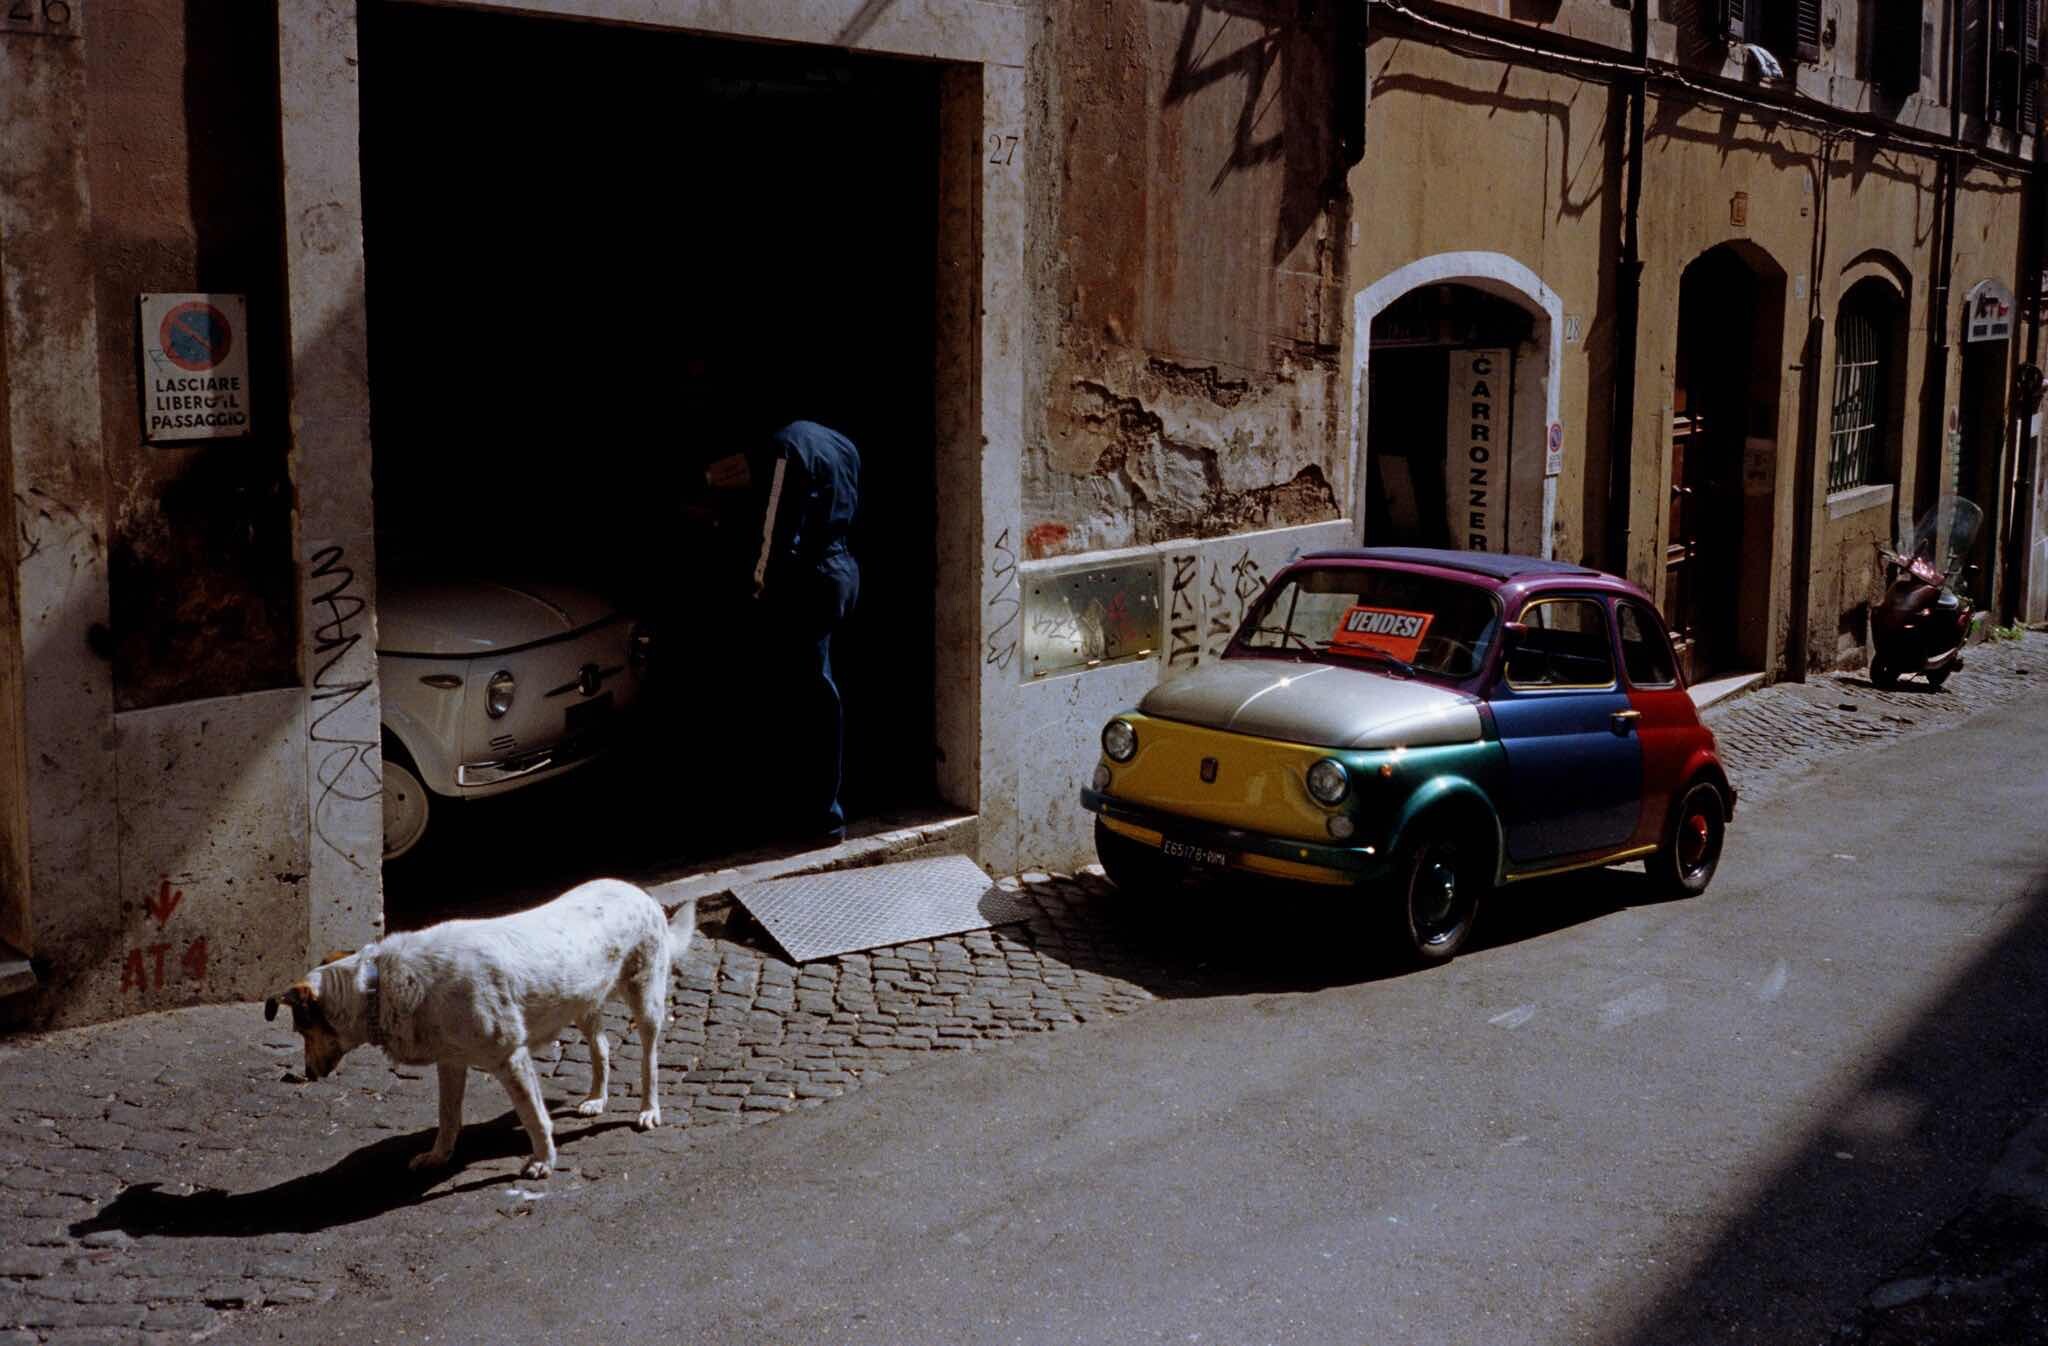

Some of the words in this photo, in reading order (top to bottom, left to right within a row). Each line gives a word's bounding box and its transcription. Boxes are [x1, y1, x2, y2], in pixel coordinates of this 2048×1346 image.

[988, 134, 1019, 166] 27
[1566, 317, 1581, 341] 28
[156, 377, 241, 393] LASCIARE
[157, 395, 217, 411] LIBERO
[223, 394, 240, 410] IL
[151, 413, 246, 429] PASSAGGIO
[1469, 358, 1491, 551] CARROZZER
[1346, 611, 1426, 638] VENDESI
